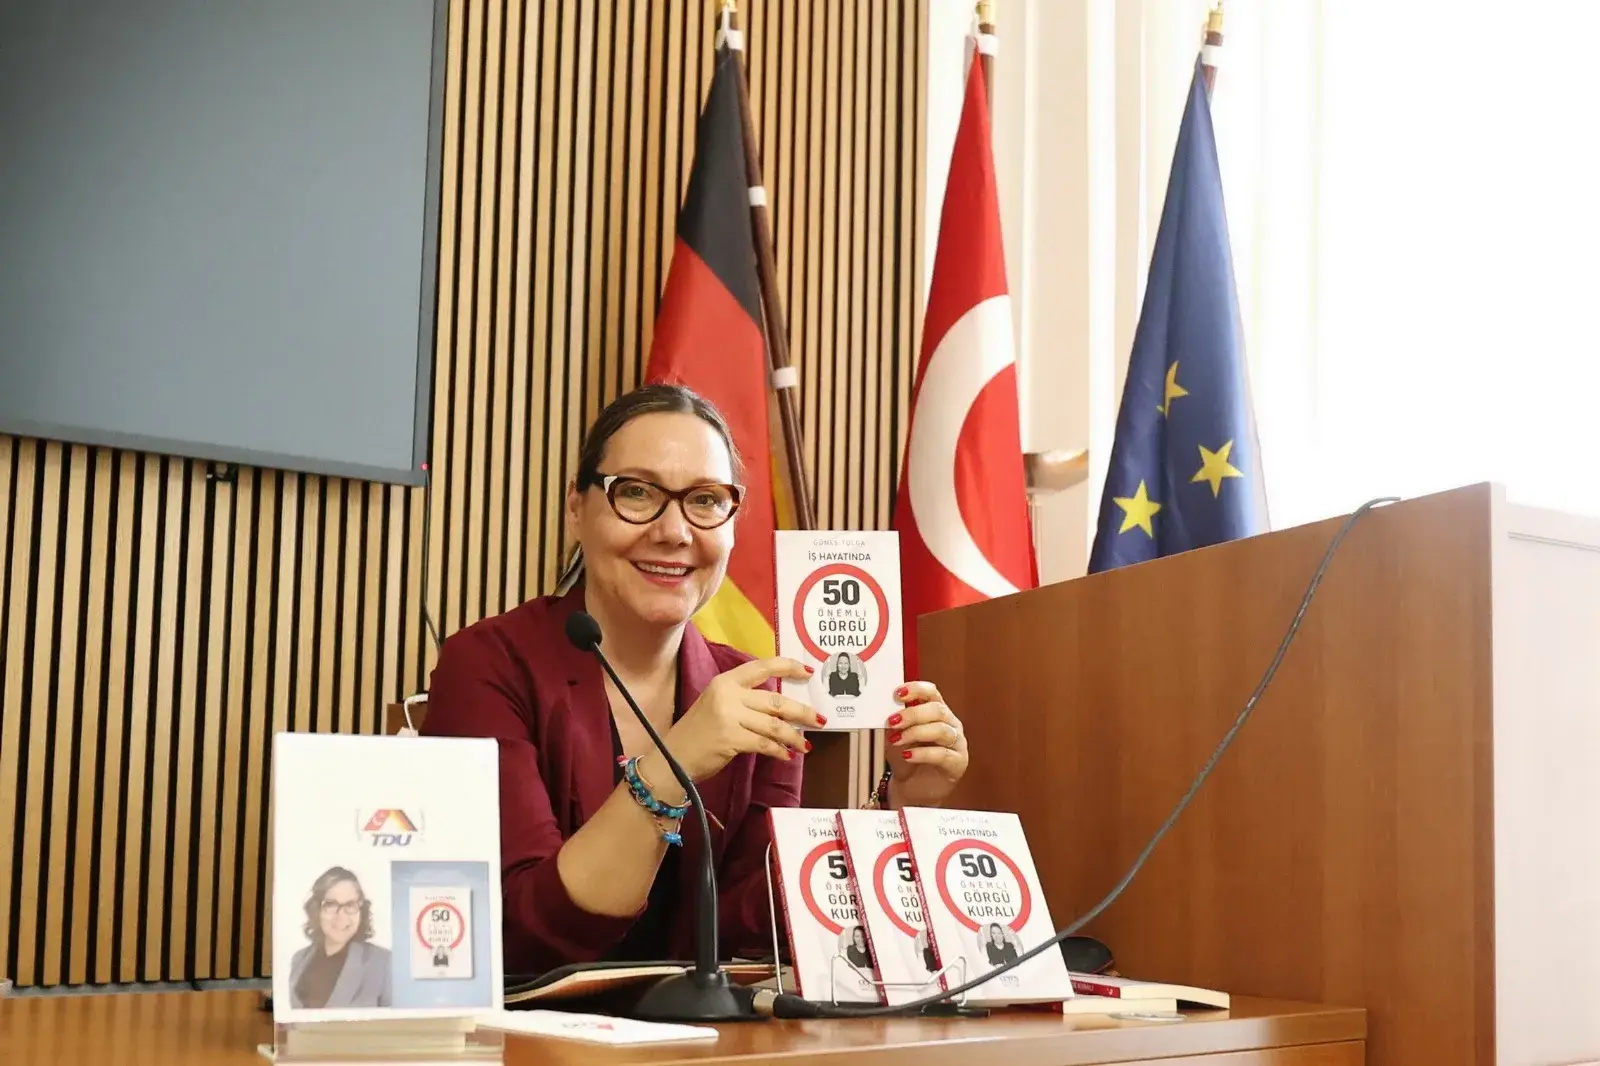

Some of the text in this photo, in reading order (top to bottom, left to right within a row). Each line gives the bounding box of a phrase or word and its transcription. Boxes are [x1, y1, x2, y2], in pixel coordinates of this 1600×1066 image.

[808, 550, 872, 562] İŞ HAYATINDA
[823, 579, 860, 605] 50
[819, 617, 866, 631] GÖRGÜ
[819, 635, 867, 646] KURALI
[948, 828, 998, 837] HAYATINDA
[371, 833, 413, 848] TDU
[828, 855, 849, 880] 5
[896, 857, 916, 882] 5
[959, 854, 997, 879] 50
[829, 891, 858, 906] GÖR
[964, 889, 1010, 903] GÖRGÜ
[431, 909, 450, 922] 50
[831, 908, 859, 920] KUR
[967, 906, 1015, 917] KURALI
